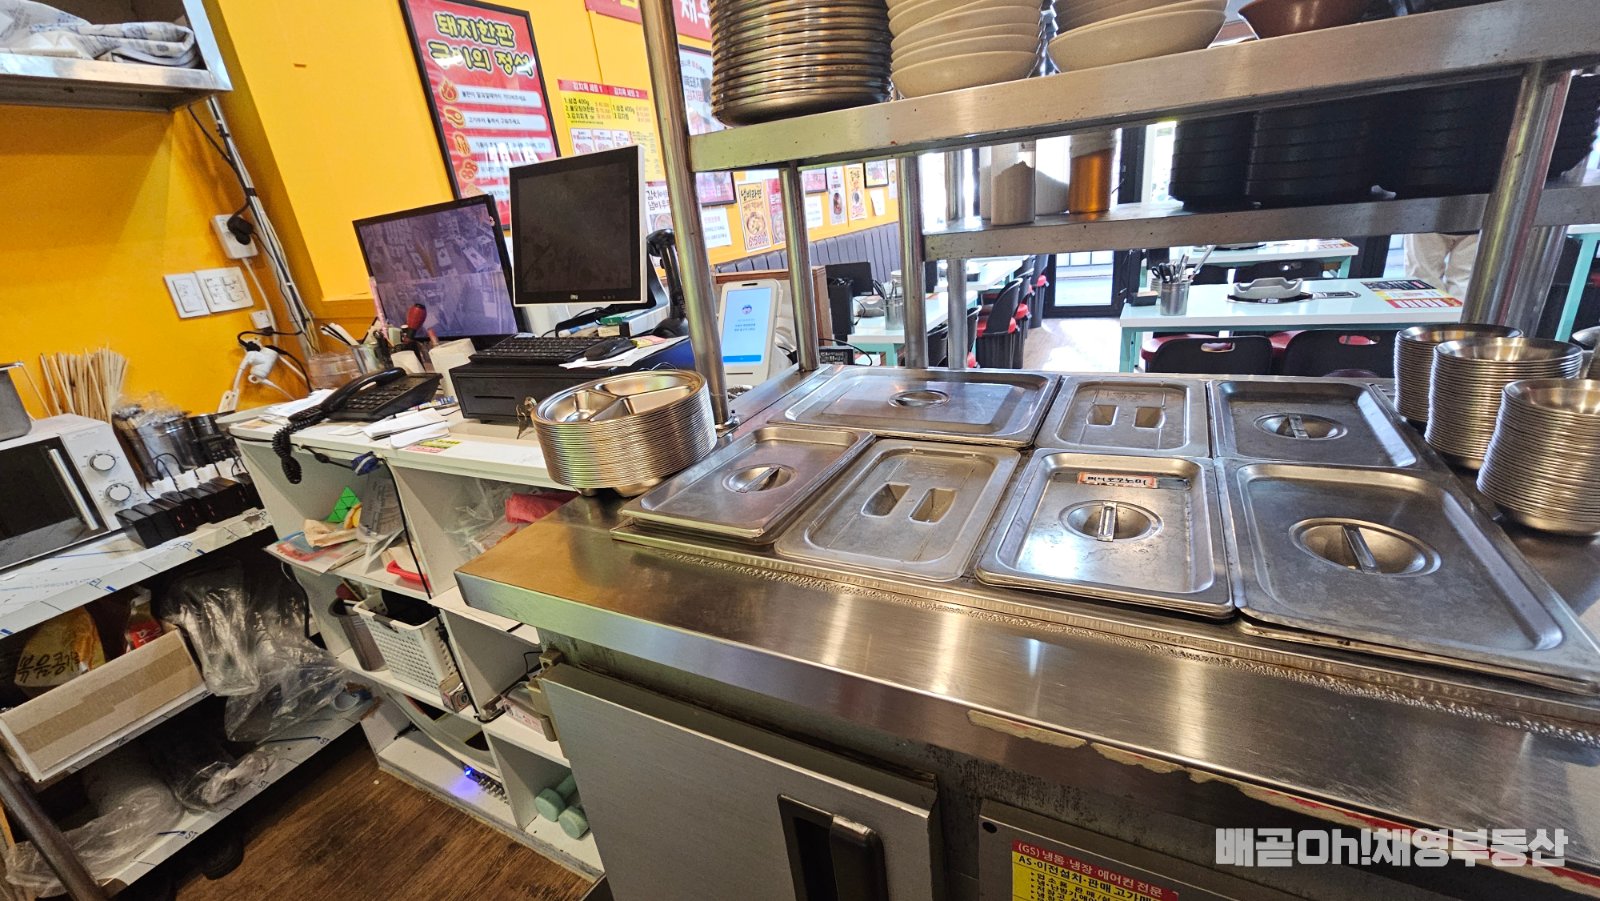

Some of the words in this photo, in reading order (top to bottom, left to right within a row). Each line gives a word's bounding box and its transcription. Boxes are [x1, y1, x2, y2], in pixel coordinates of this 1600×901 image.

[434, 12, 516, 49] 돼지한판
[1018, 842, 1040, 858] (GS)
[1136, 881, 1163, 898] 전문
